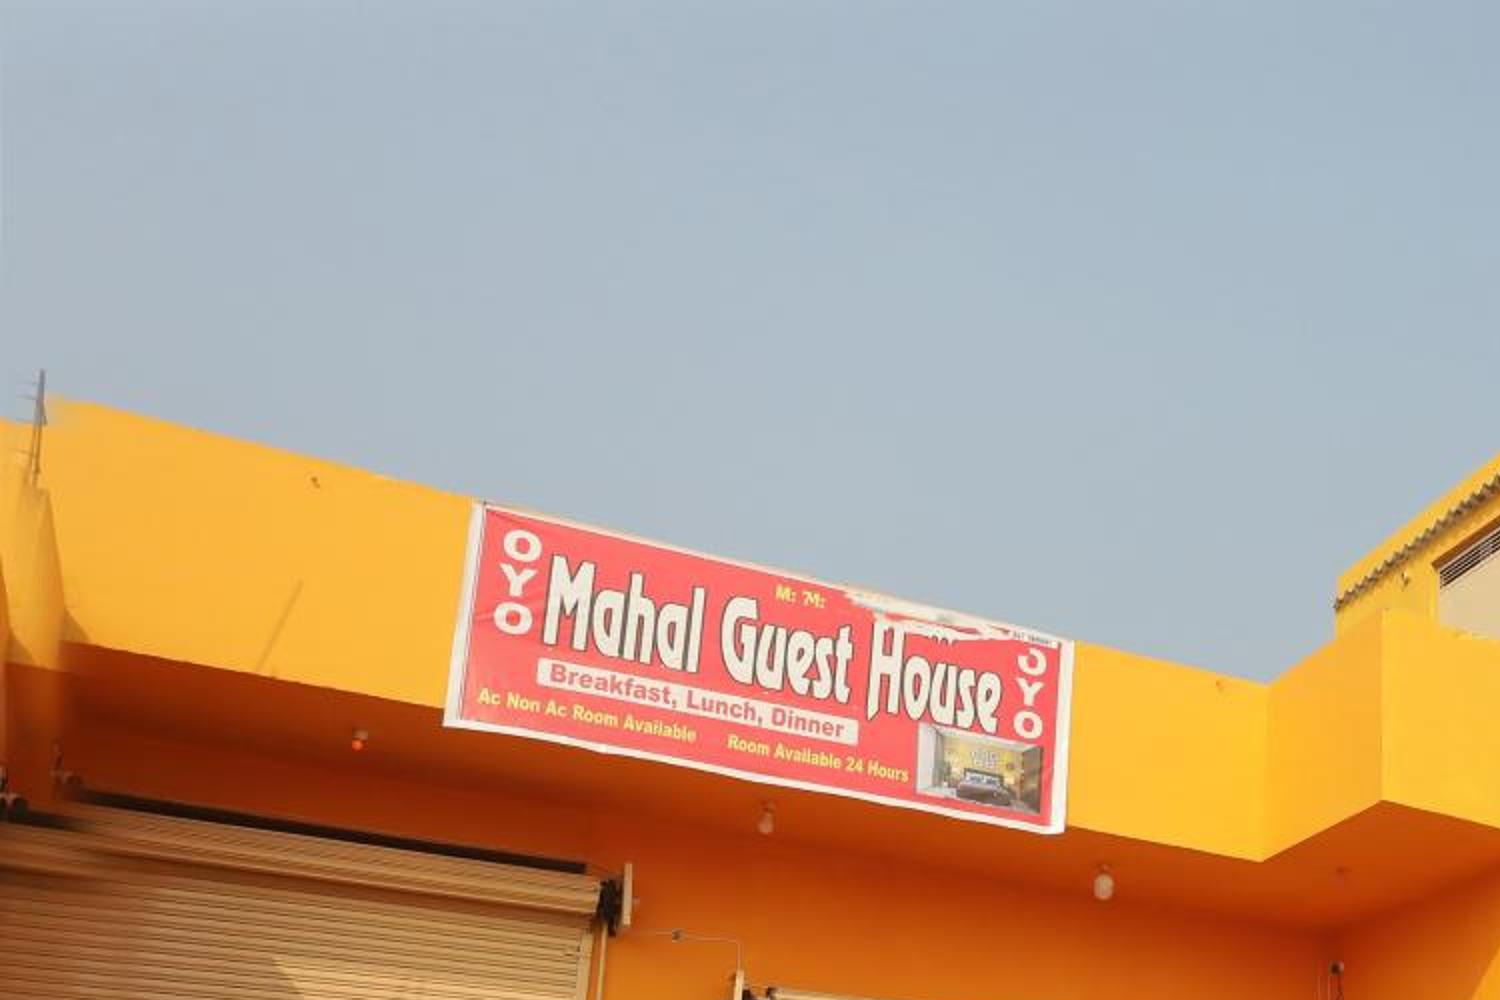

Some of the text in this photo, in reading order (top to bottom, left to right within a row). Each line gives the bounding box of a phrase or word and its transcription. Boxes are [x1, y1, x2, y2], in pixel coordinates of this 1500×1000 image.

[493, 529, 543, 635] OYO
[542, 553, 1003, 734] Mahal Guest House
[478, 688, 697, 742] Ac Non Ac Room Available
[550, 662, 846, 739] Breakfast, Lunch, Dinner
[727, 734, 909, 784] Room Available 24 Hours
